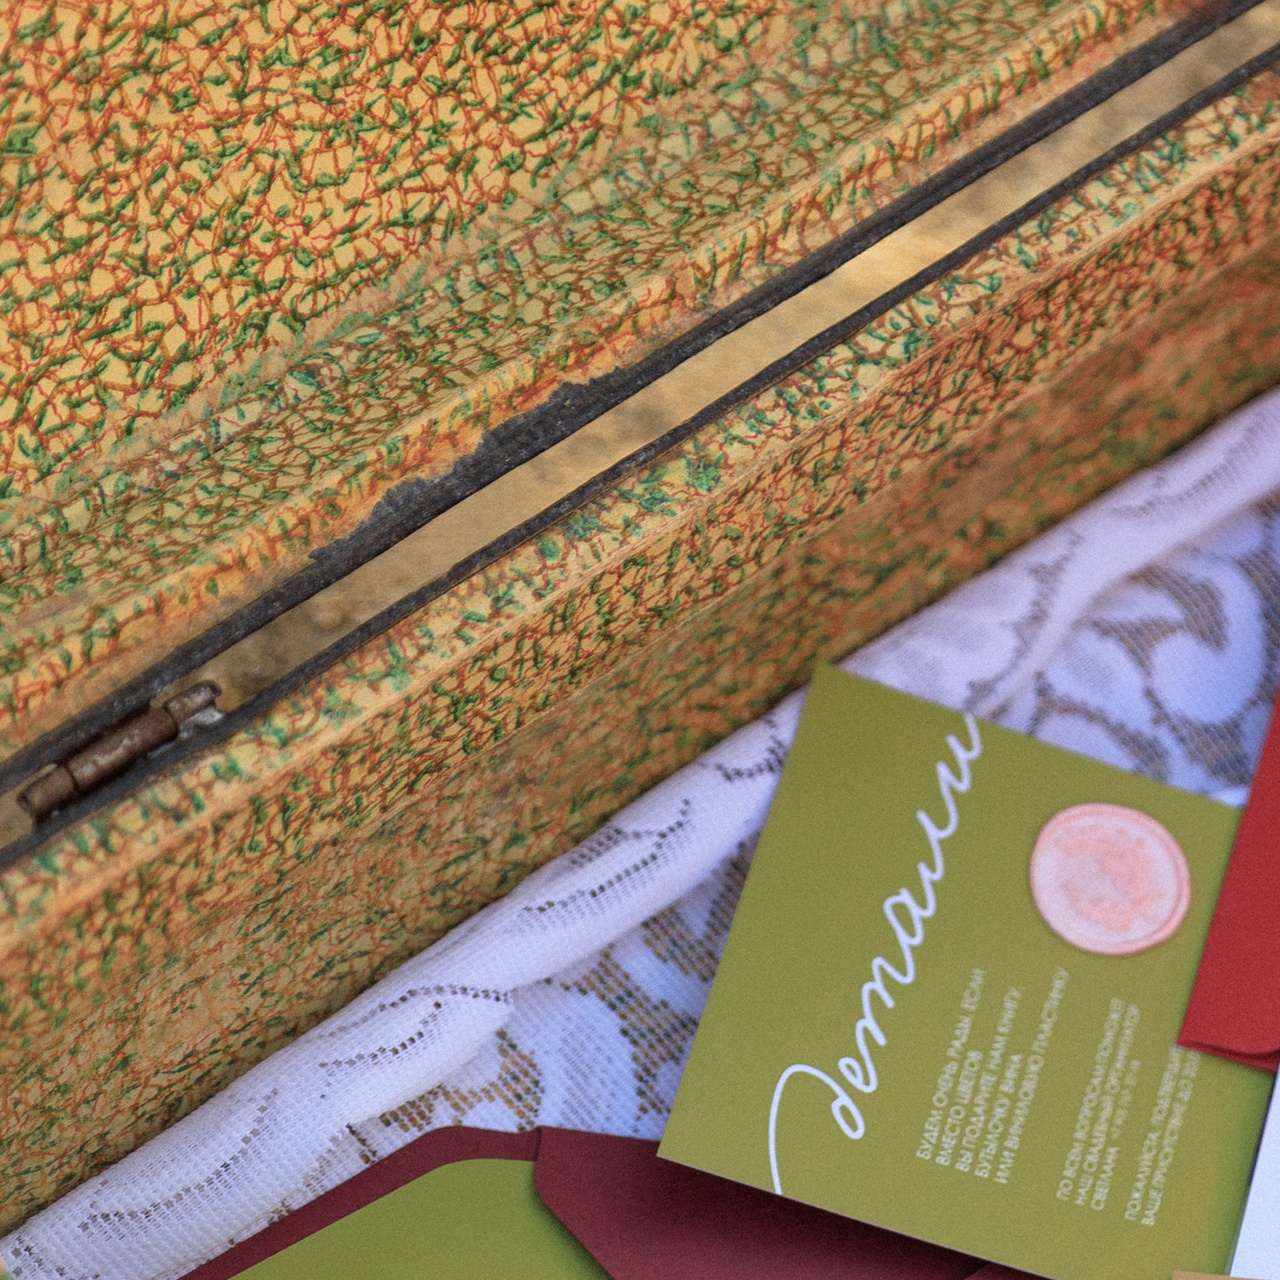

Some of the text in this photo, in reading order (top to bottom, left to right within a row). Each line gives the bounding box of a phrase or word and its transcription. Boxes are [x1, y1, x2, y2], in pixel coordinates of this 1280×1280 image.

[916, 1108, 943, 1160] БУДЕМ
[932, 1060, 958, 1108] ОЧЕНЬ
[961, 968, 986, 1011] ЕСЛИ
[987, 1035, 1006, 1070] НАМ
[994, 967, 1070, 1184] ИЛИ ВИНИЛОВУЮ ПЛАСТИНКУ
[936, 1050, 982, 1166] ВМЕСТО ЦВЕТОВ
[962, 1072, 997, 1148] ПОДАРИТЕ
[974, 1053, 1022, 1178] БУТЫЛОЧКУ ВИНА
[1072, 1064, 1106, 1140] ВОПРОСАМ
[1080, 1094, 1115, 1172] СВАДЕБНЫЙ
[955, 1150, 973, 1172] ВЫ
[1056, 1178, 1074, 1200] ПО
[1062, 1141, 1084, 1178] ВСЕМ
[1075, 1175, 1092, 1205] НАШ
[1090, 1146, 1119, 1211] СВЕТЛАНА
[1141, 1188, 1163, 1226] ВАШЕ
